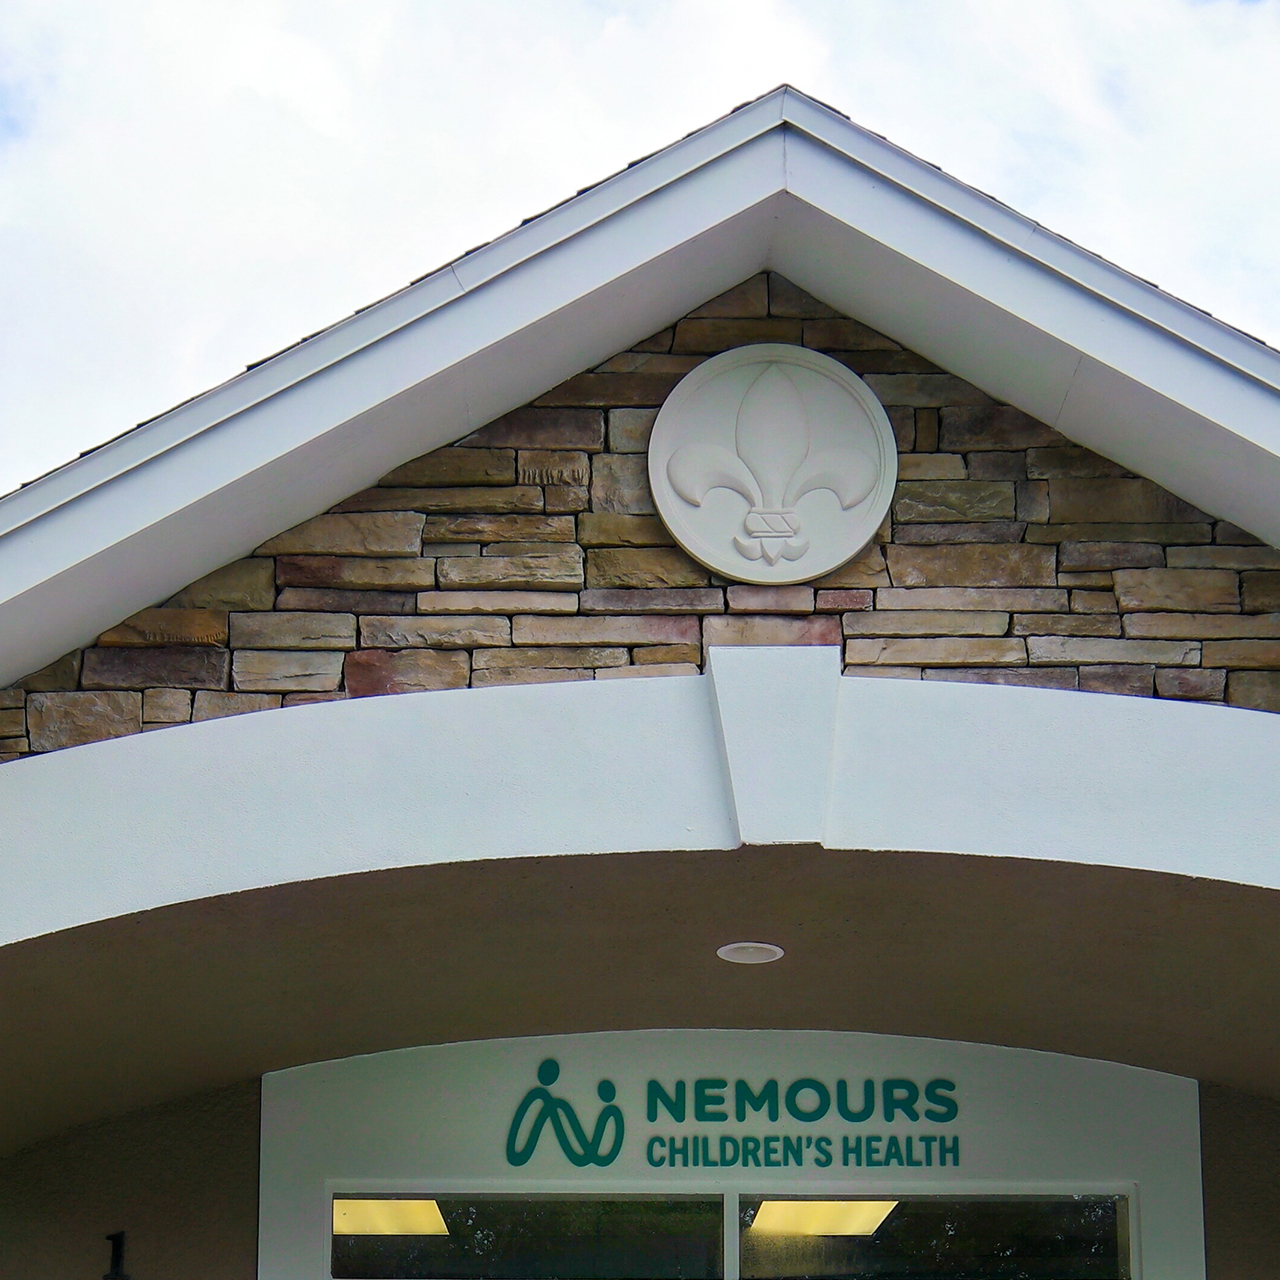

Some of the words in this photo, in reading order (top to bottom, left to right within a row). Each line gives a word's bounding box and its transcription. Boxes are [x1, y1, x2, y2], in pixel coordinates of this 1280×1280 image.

[646, 1078, 959, 1124] NEMOURS
[646, 1135, 833, 1168] CHILDREN'S
[842, 1135, 960, 1168] HEALTH
